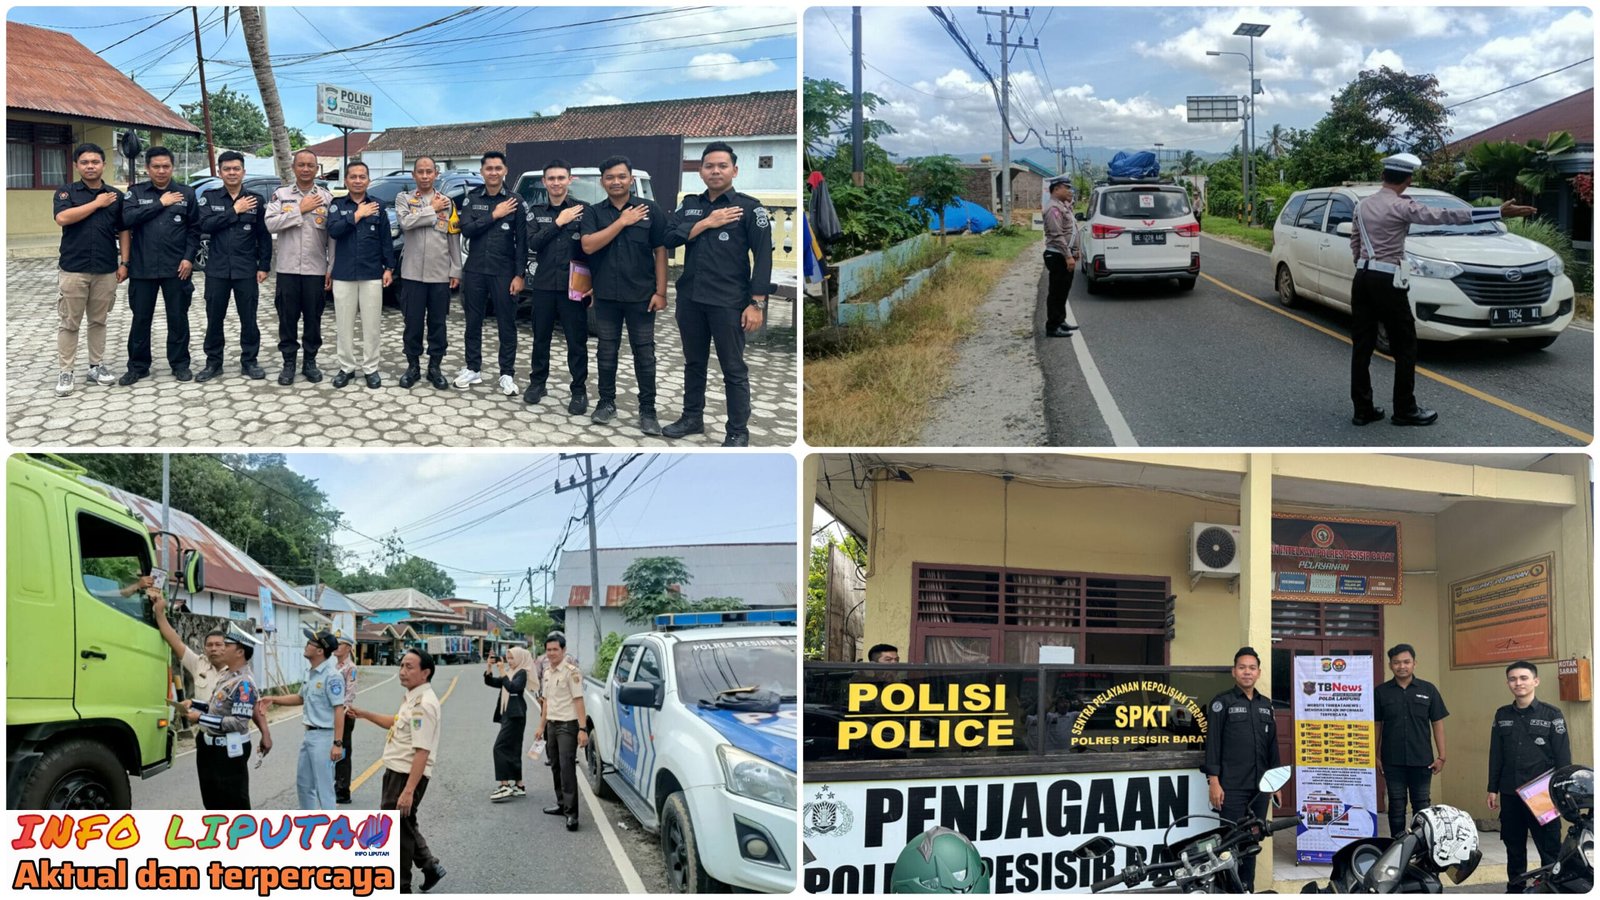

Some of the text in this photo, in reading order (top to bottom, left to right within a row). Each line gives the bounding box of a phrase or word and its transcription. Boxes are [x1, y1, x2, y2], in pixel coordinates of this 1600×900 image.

[340, 90, 372, 106] POLISI
[1493, 310, 1499, 320] A
[1508, 308, 1522, 319] 1164
[1298, 560, 1350, 572] PELAYANAN
[692, 641, 735, 651] POLRES
[736, 640, 778, 648] PESISIR
[1318, 683, 1362, 692] TBNews
[848, 683, 1006, 713] POLISI
[1071, 704, 1097, 735] SENTRA
[1092, 681, 1140, 707] PELAYANAN
[1141, 681, 1188, 704] KEPOLISIAN
[1115, 705, 1171, 728] SPKT
[837, 719, 1015, 750] POLICE
[1070, 736, 1120, 746] POLRES
[1123, 735, 1170, 744] PESISIR
[864, 775, 1190, 848] PENJAGAAN
